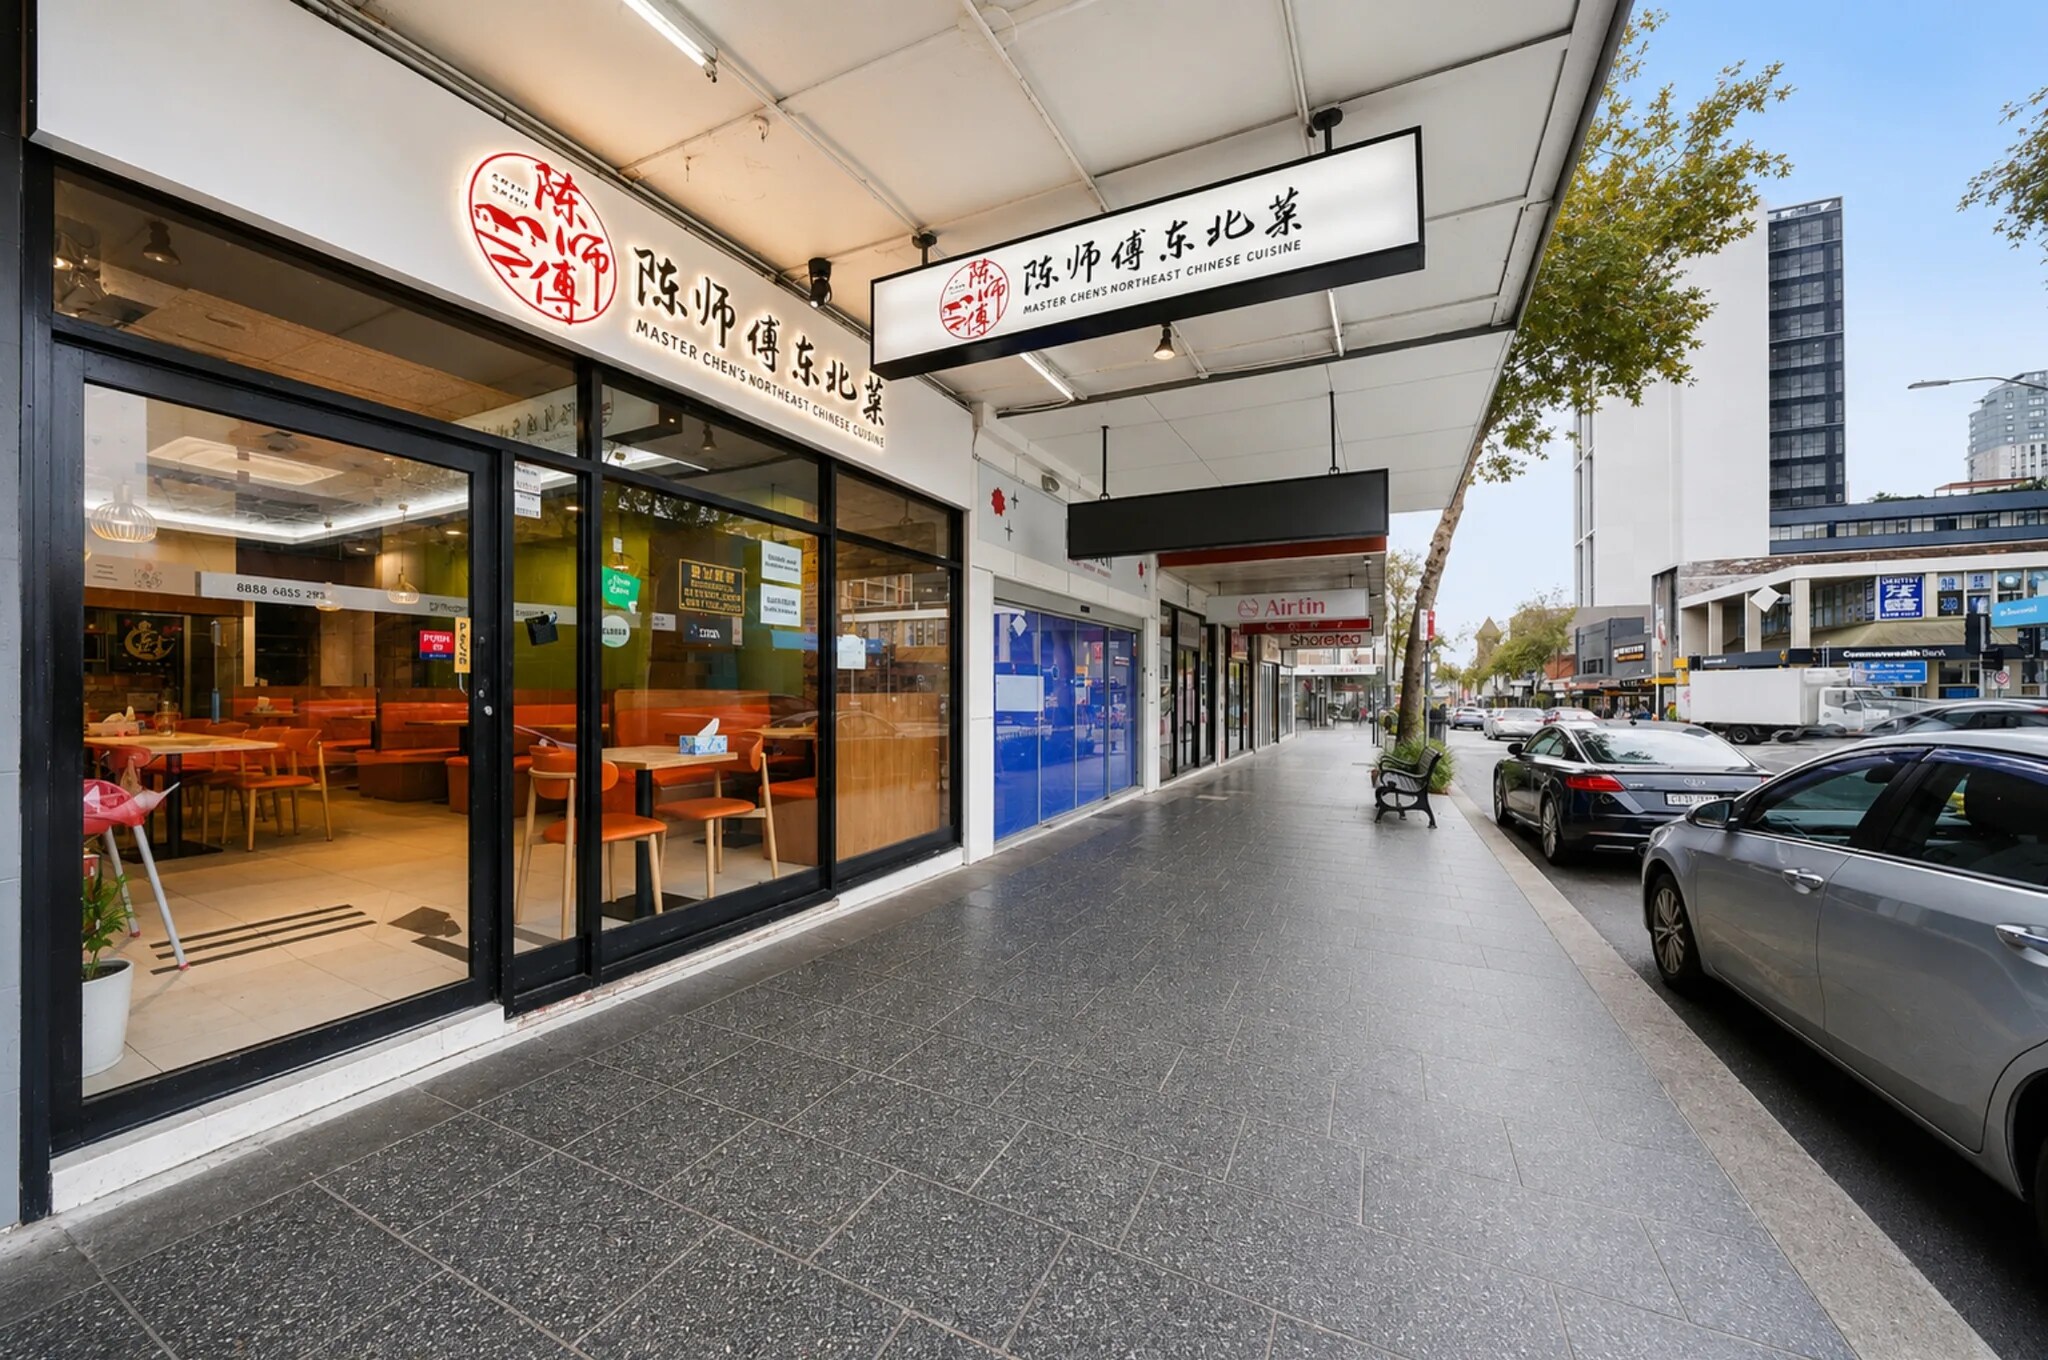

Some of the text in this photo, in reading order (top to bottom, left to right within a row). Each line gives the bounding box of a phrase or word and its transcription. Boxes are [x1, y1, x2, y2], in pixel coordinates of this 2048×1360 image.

[1022, 239, 1302, 315] MASTER CHEN'S NORTHEAST CHINESE CUISINE
[1023, 186, 1302, 296] 陈师傅东北菜
[633, 247, 885, 426] 陈师傅东北菜
[636, 319, 698, 360] MASTER
[702, 352, 747, 383] CHEN'S
[748, 374, 809, 412] NORTHEAST
[812, 405, 851, 433] CHINESE
